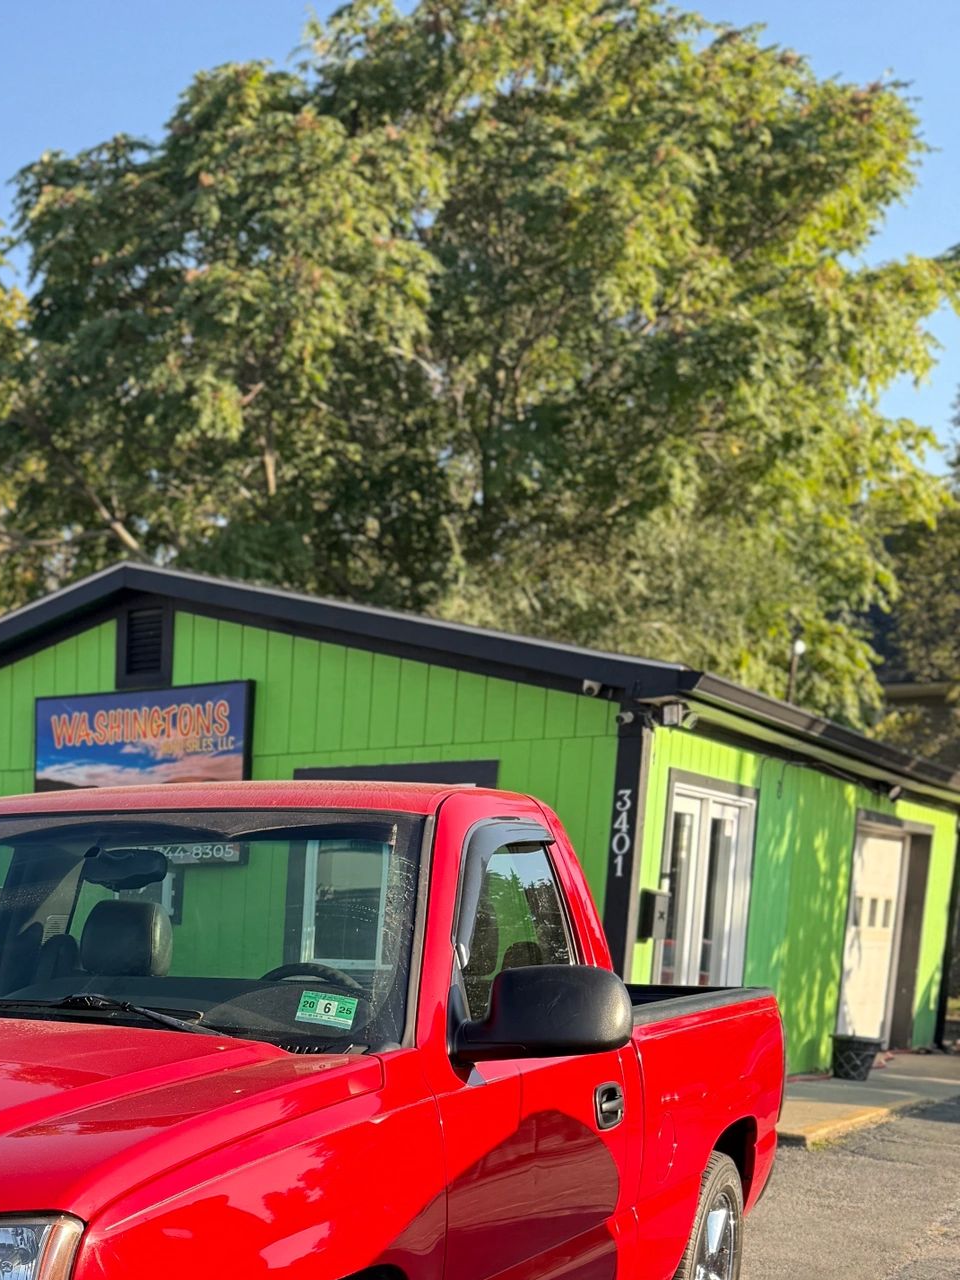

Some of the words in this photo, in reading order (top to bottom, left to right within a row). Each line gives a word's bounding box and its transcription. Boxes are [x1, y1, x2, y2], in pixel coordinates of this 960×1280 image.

[50, 700, 231, 749] WASHINGTONS
[218, 736, 236, 751] LLC
[612, 789, 633, 877] 3401
[302, 1000, 315, 1009] 20
[323, 1002, 332, 1014] 6
[339, 1006, 352, 1015] 25
